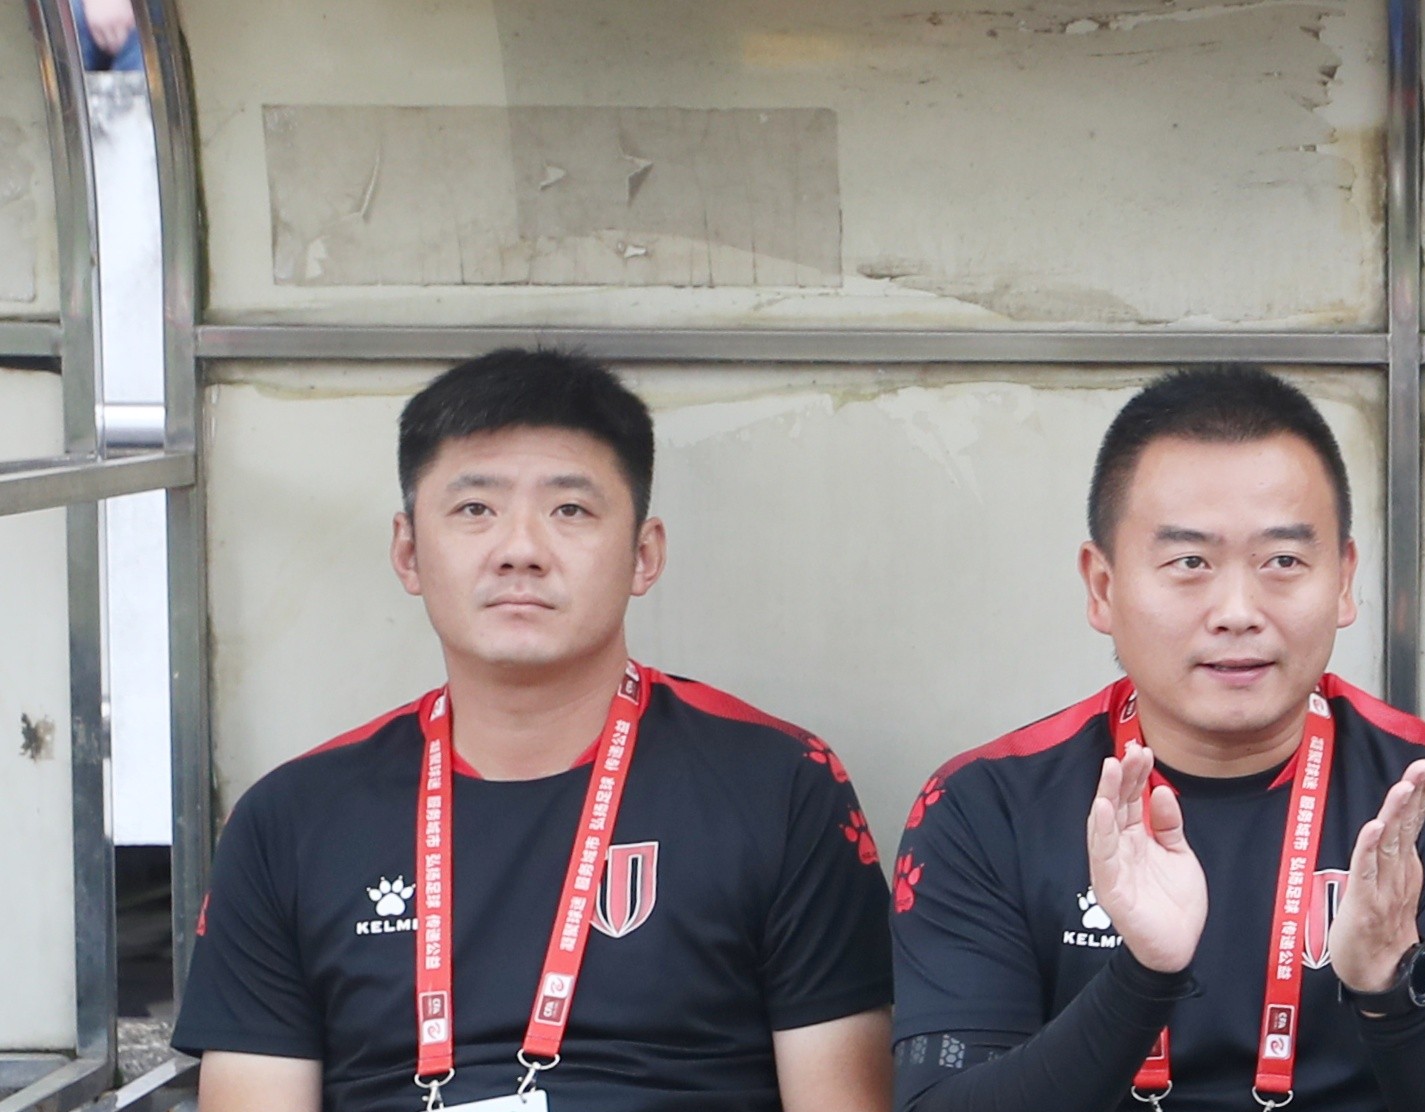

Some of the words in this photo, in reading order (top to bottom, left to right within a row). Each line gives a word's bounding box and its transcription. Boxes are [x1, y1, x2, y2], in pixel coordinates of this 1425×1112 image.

[426, 795, 442, 847] 服务城市
[574, 836, 600, 891] 服务城市
[589, 776, 615, 830] 弘扬足球
[604, 720, 631, 771] 传递公益
[1293, 795, 1316, 850] 服务城市
[425, 853, 442, 909] 弘扬足球
[1284, 857, 1307, 914] 弘扬足球
[425, 914, 442, 970] 传递公益
[1277, 920, 1298, 980] 传递公益
